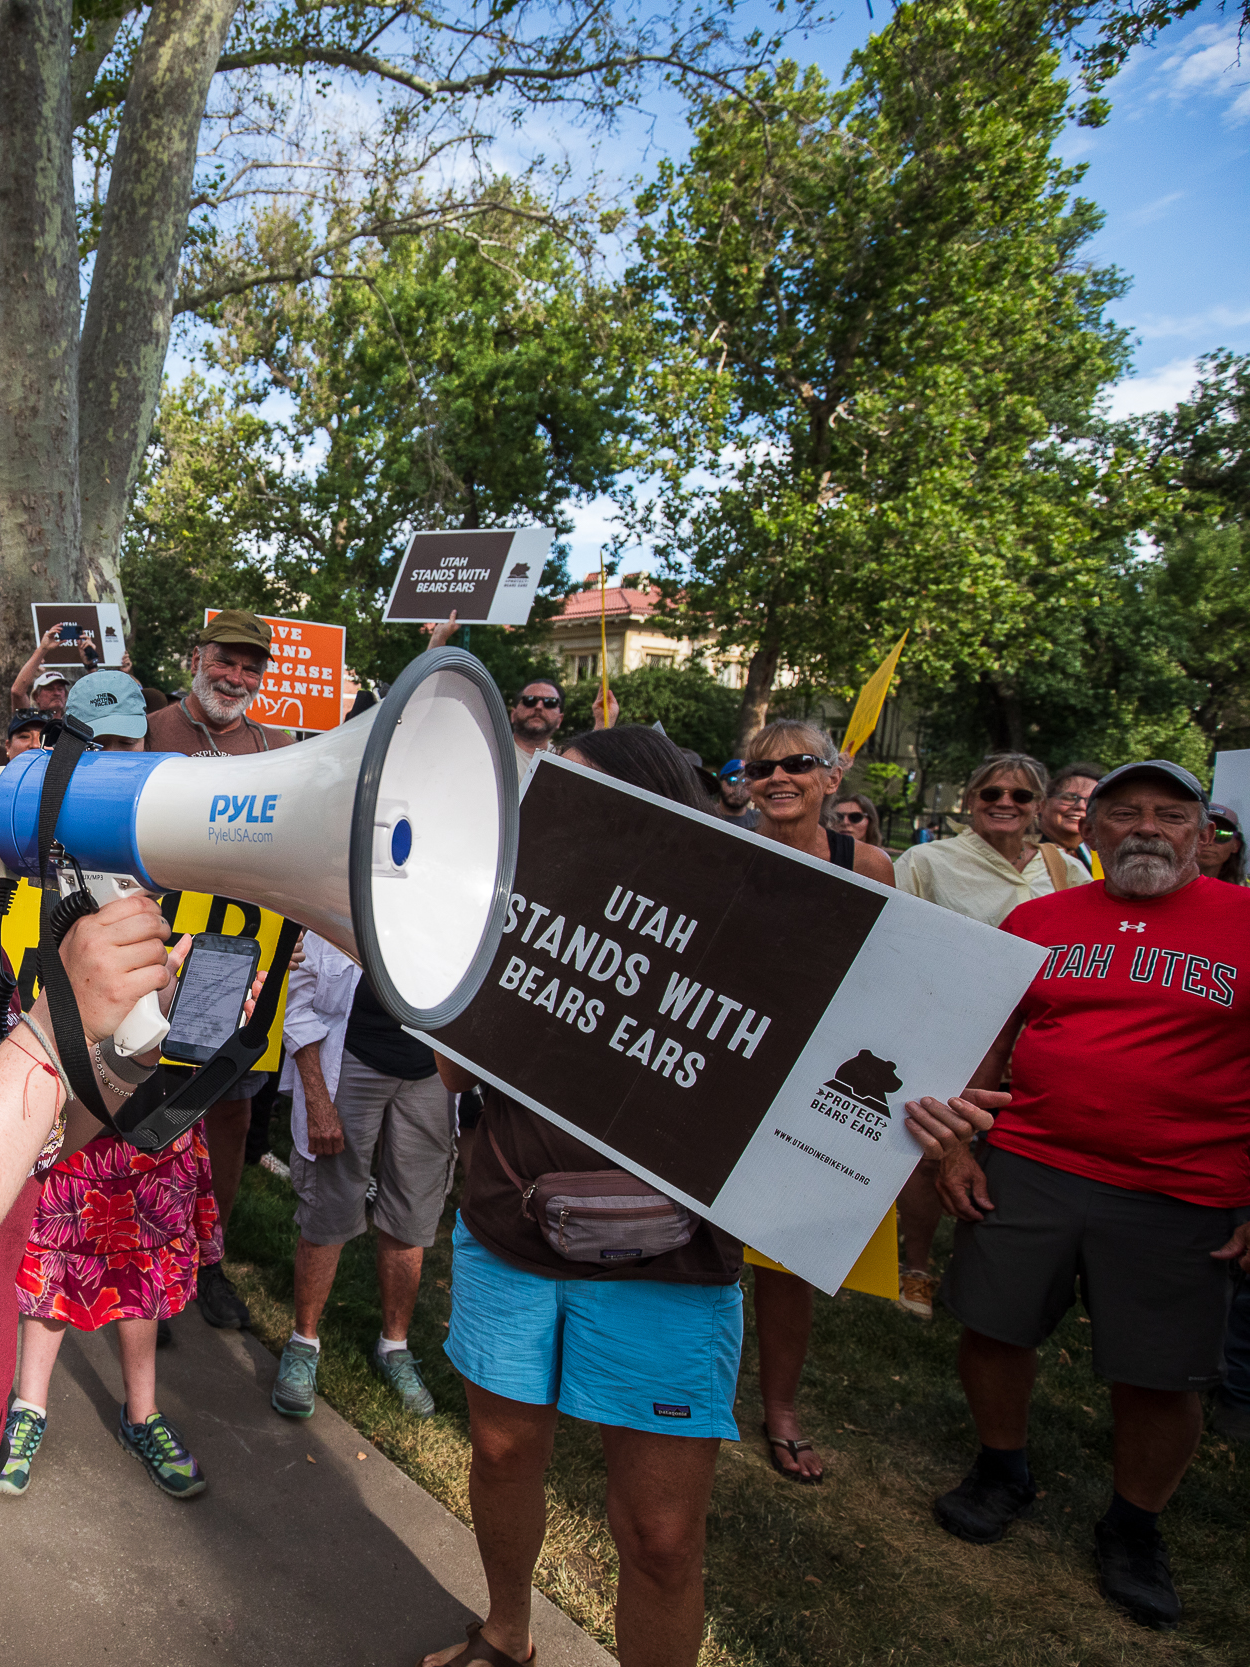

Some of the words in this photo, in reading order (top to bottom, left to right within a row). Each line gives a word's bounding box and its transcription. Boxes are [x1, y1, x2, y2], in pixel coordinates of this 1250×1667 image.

[440, 557, 468, 567] UTAH
[410, 569, 455, 581] STANDS
[457, 568, 490, 581] WITH
[416, 582, 450, 593] BEARS
[449, 582, 475, 593] EARS
[269, 625, 302, 640] AVE
[270, 643, 311, 659] AND
[266, 661, 332, 680] RCASE
[261, 679, 334, 698] LANTE
[90, 697, 108, 705] NORTH
[209, 794, 278, 823] PYLE
[208, 827, 273, 845] PyleUSA.com
[604, 885, 698, 953] UTAH
[502, 893, 650, 996] STANDS
[658, 971, 771, 1059] WITH
[1043, 944, 1115, 979] TAH
[1130, 946, 1237, 1008] UTES
[498, 955, 605, 1034] BEARS
[608, 1014, 706, 1088] EARS
[824, 1091, 883, 1127] PROTECT
[810, 1098, 848, 1124] BEARS
[850, 1120, 882, 1142] EARS
[774, 1128, 871, 1186] WWW.UTAHDINEBIKEYAH.ORG
